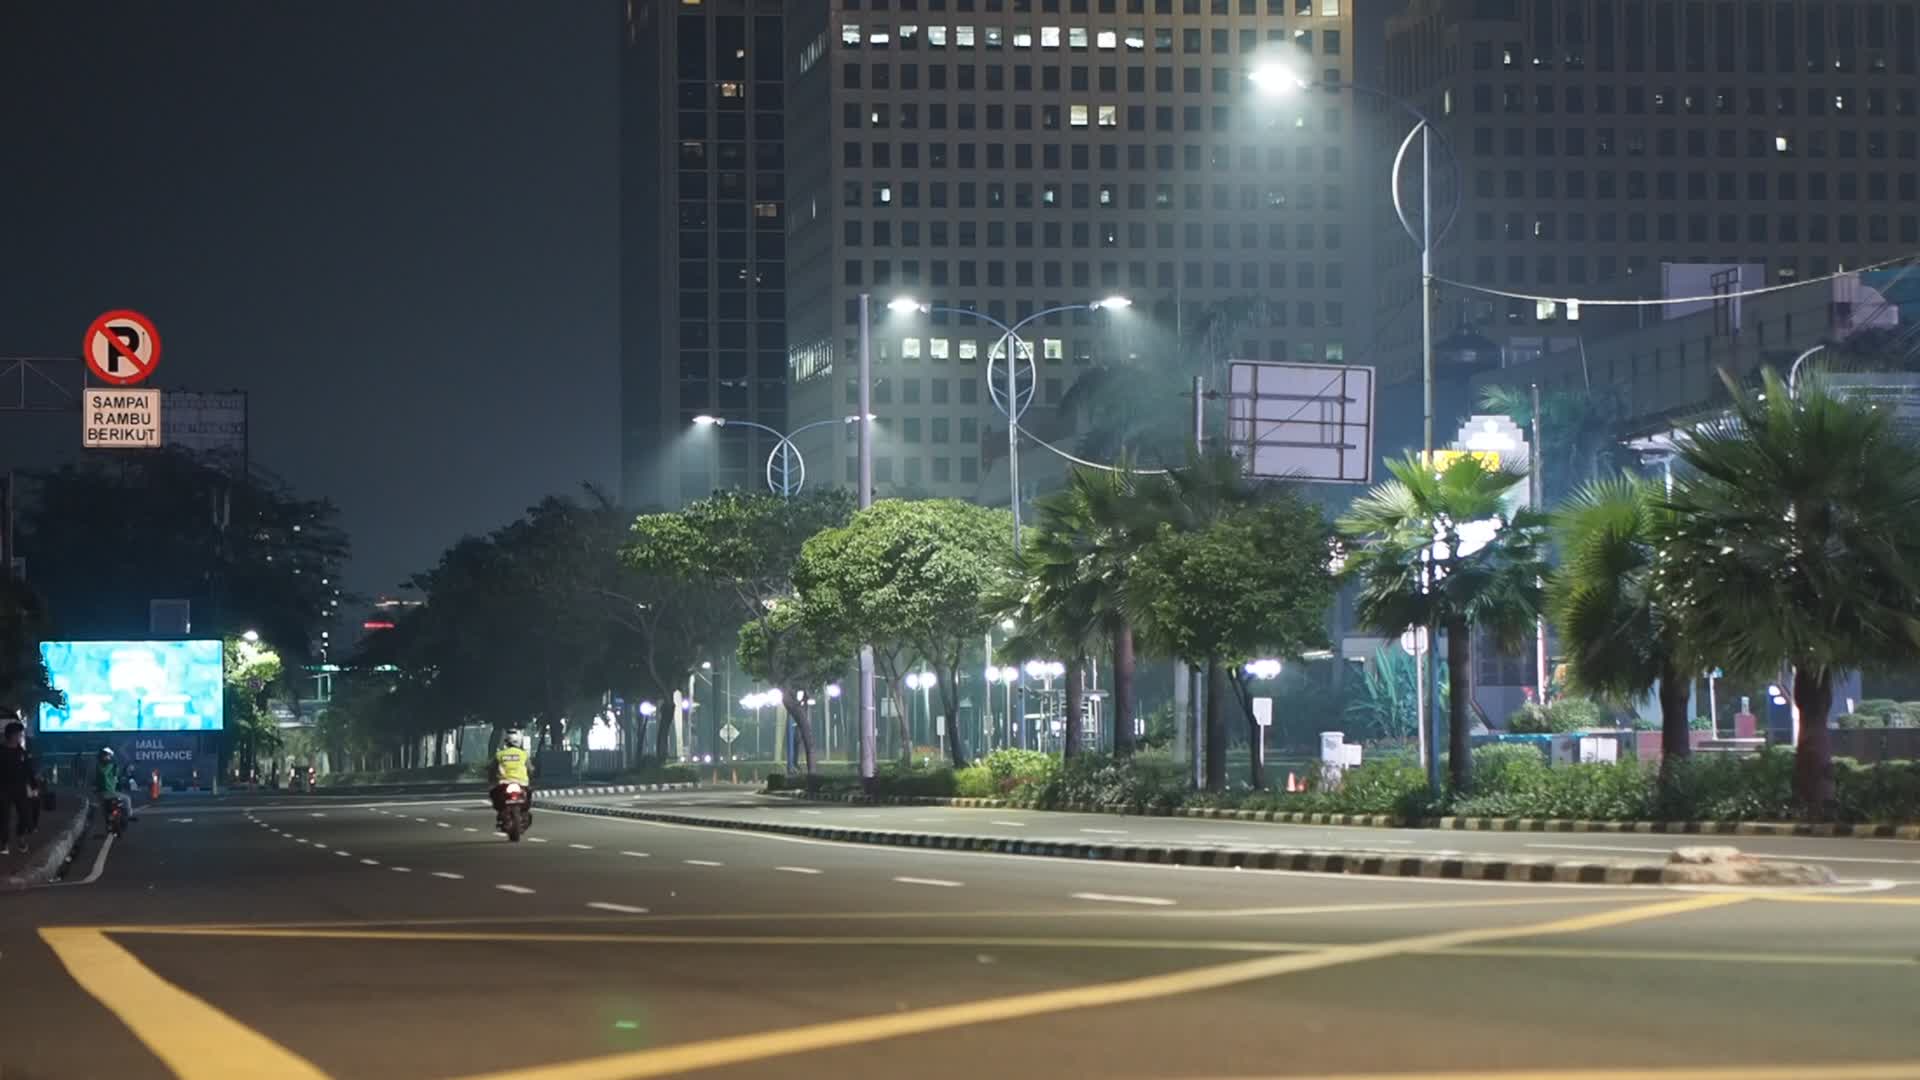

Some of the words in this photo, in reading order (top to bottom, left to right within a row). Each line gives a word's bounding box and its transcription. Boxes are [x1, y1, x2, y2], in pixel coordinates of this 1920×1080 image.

[93, 396, 149, 408] SAMPAI
[94, 413, 151, 425] RAMBU
[88, 428, 155, 441] BERIKUT
[136, 739, 165, 749] MALL
[136, 750, 192, 760] ENTRANCE
